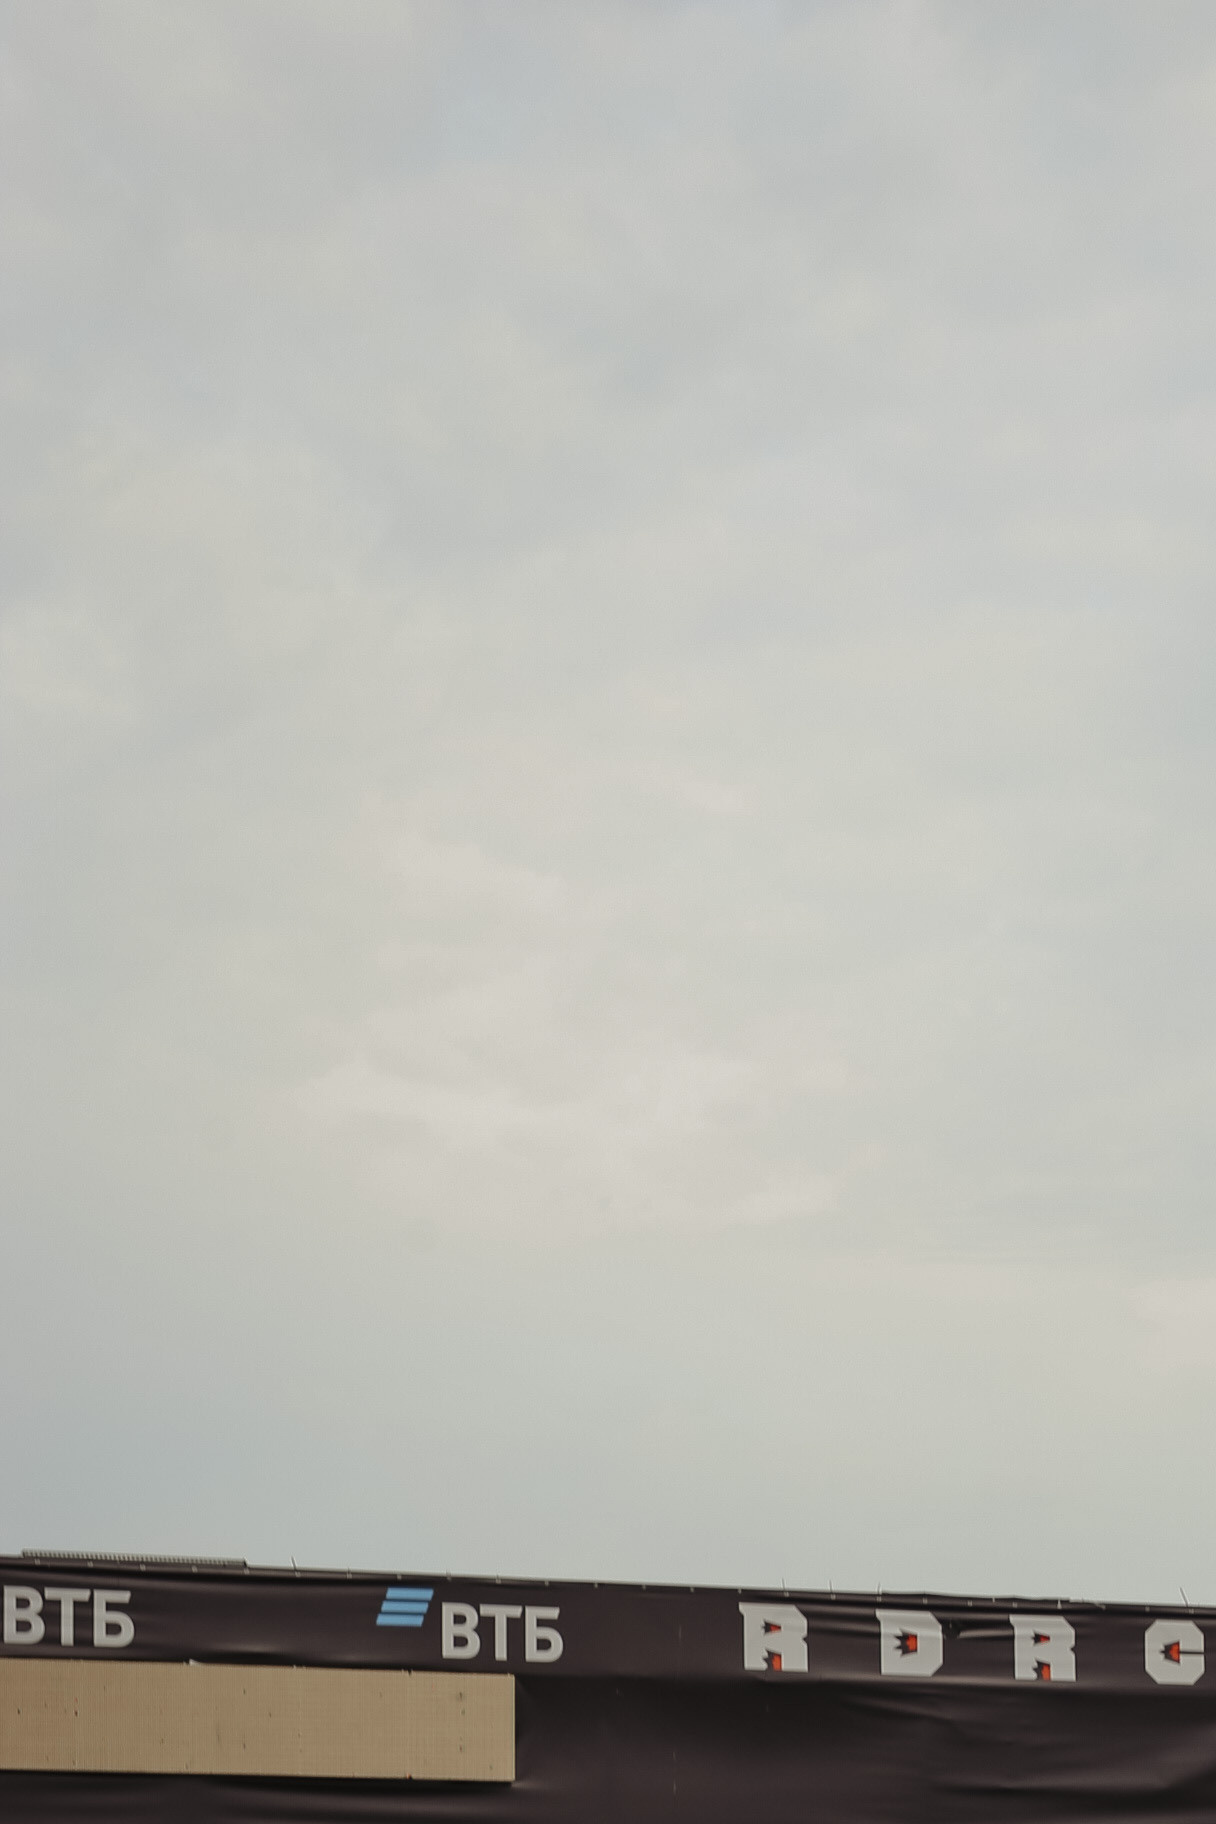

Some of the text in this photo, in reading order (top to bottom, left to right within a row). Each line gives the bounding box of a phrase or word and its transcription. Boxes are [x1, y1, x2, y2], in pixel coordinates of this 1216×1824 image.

[3, 1585, 135, 1648] ВТБ
[441, 1602, 564, 1663] ВТБ
[738, 1602, 1205, 1686] RDRC
